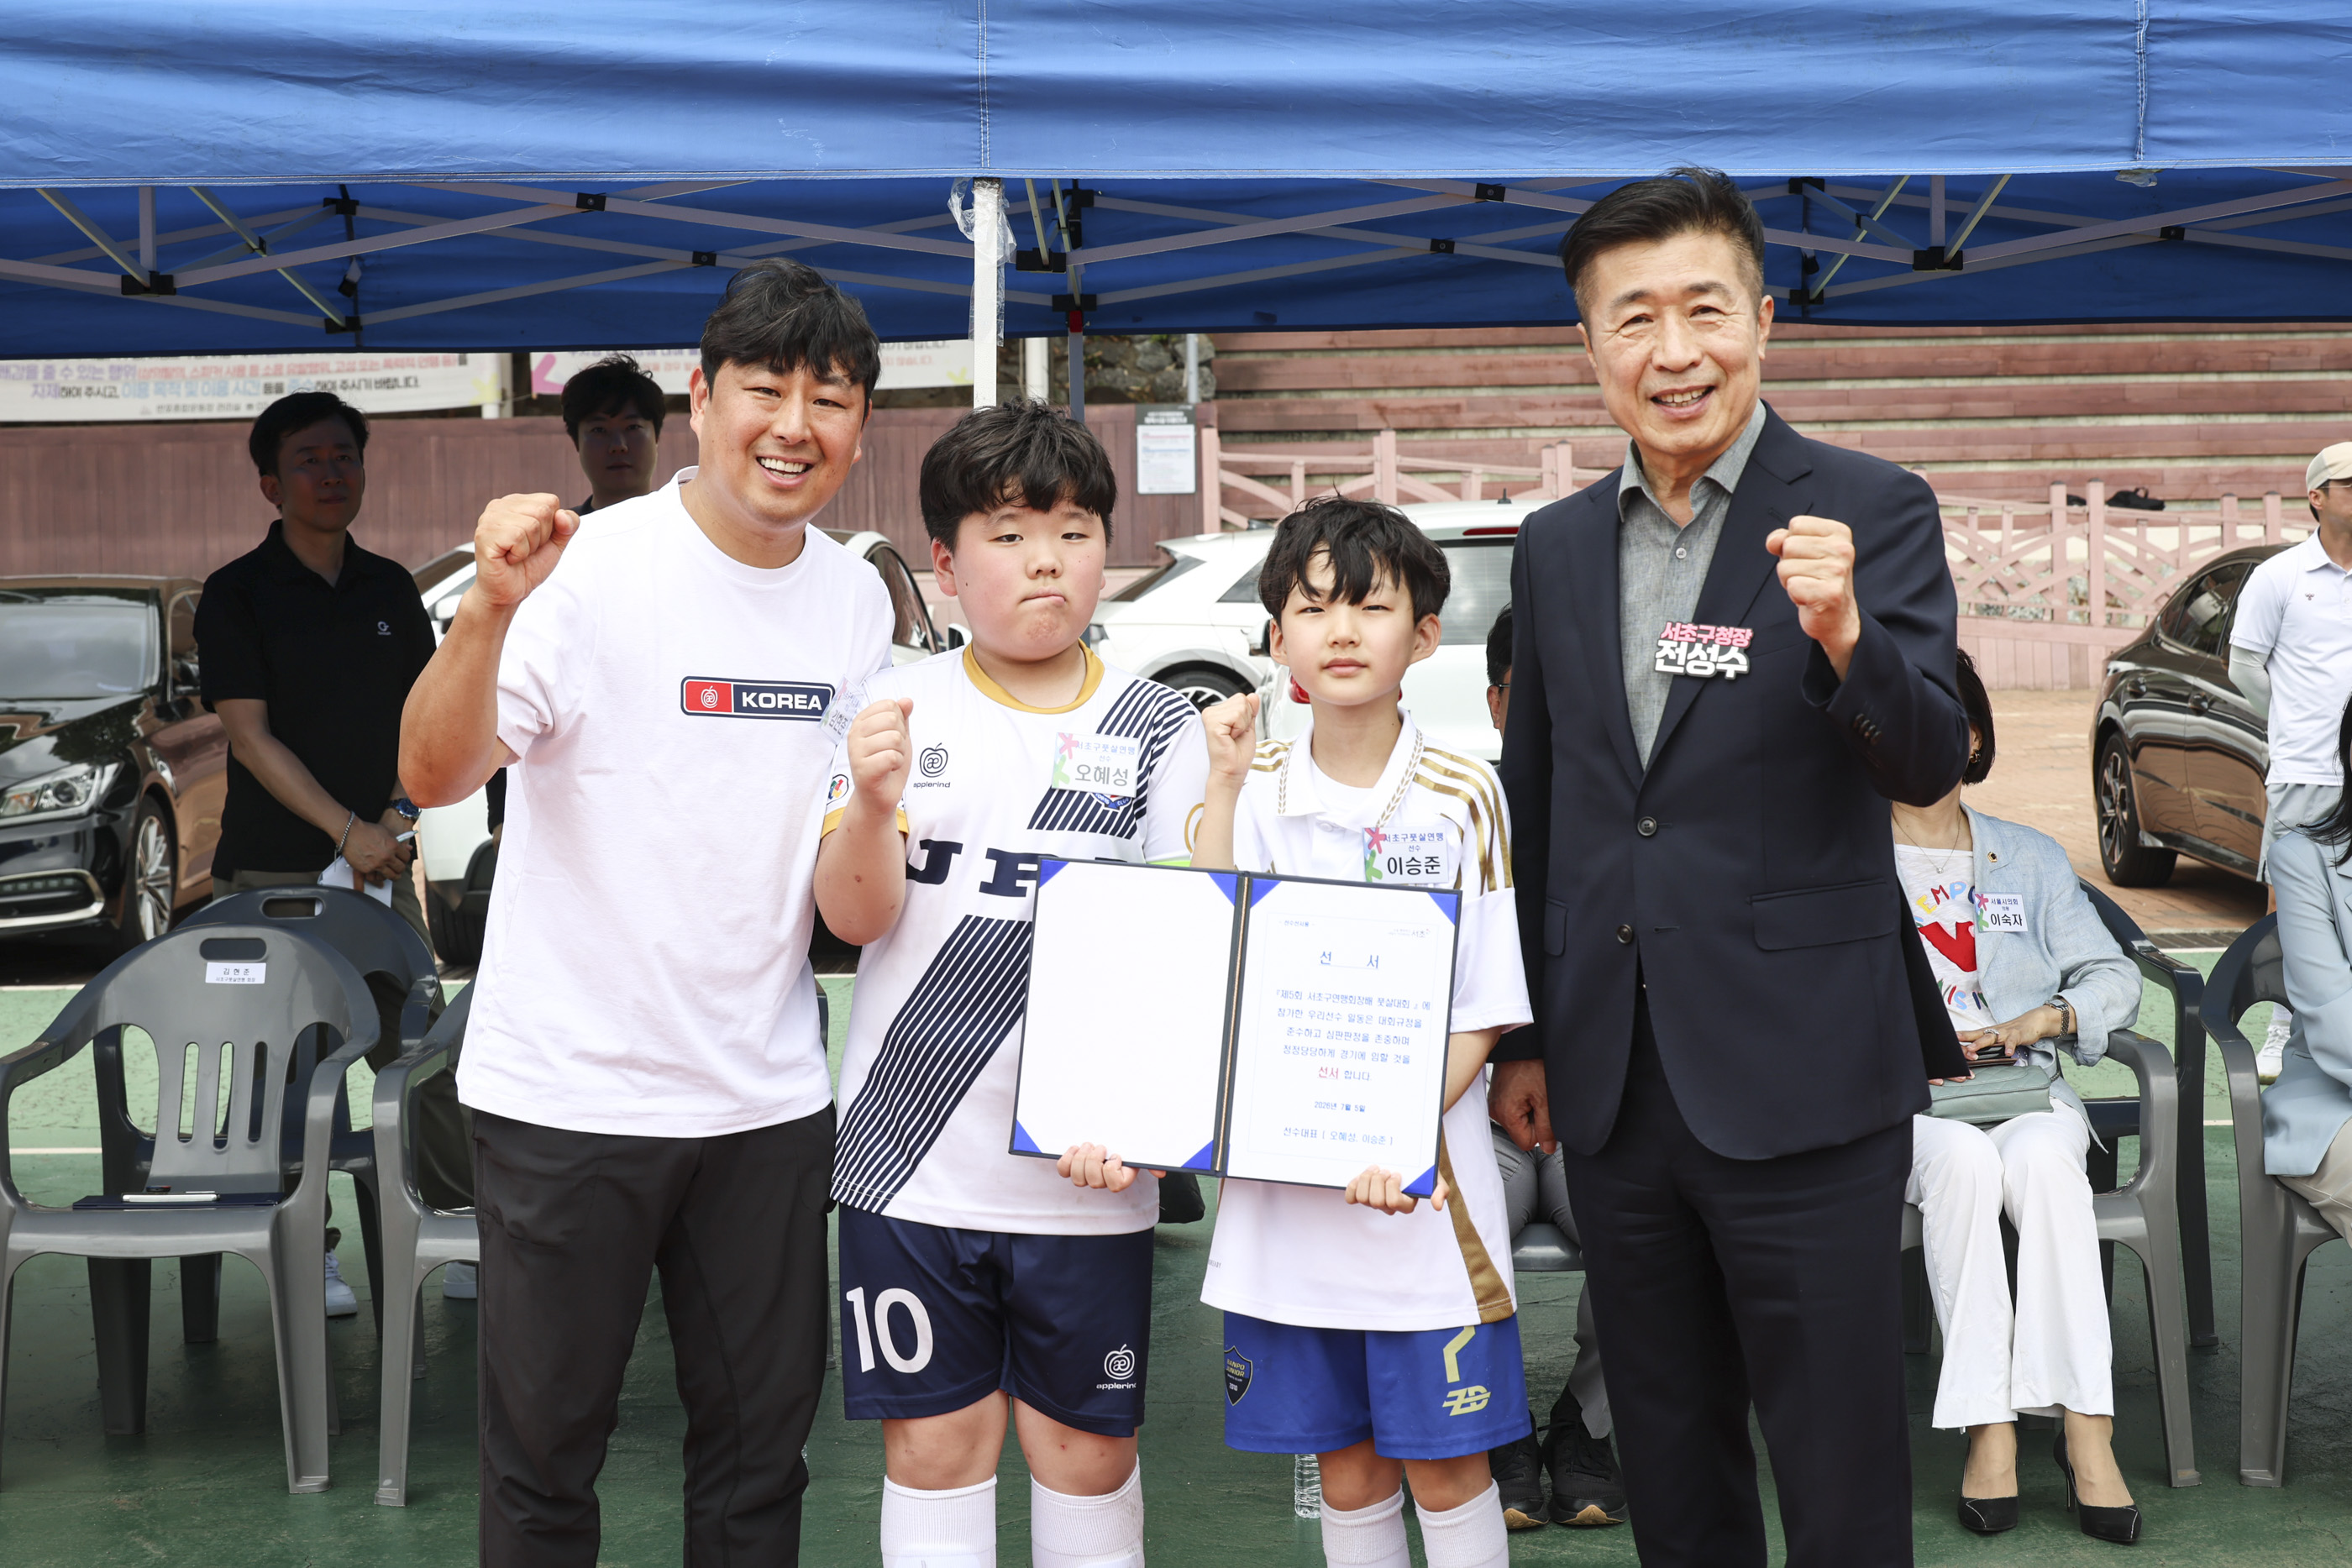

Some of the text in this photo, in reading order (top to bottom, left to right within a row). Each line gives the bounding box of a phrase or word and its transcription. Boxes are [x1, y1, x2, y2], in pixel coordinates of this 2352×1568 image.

[1660, 621, 1754, 648] 서초구청장
[1654, 639, 1749, 679] 전성수
[742, 691, 822, 711] KOREA
[913, 781, 951, 789] applerind
[1074, 763, 1129, 787] 오혜성
[1384, 832, 1445, 843] 서초구풋살연맹
[1387, 856, 1441, 876] 이승준
[1990, 913, 2023, 926] 이숙자
[1287, 1026, 1321, 1038] 준수하고
[1318, 1066, 1340, 1080] 선서
[1283, 1126, 1318, 1139] 선수대표
[1362, 1134, 1387, 1146] 이승준
[845, 1286, 934, 1374] 10
